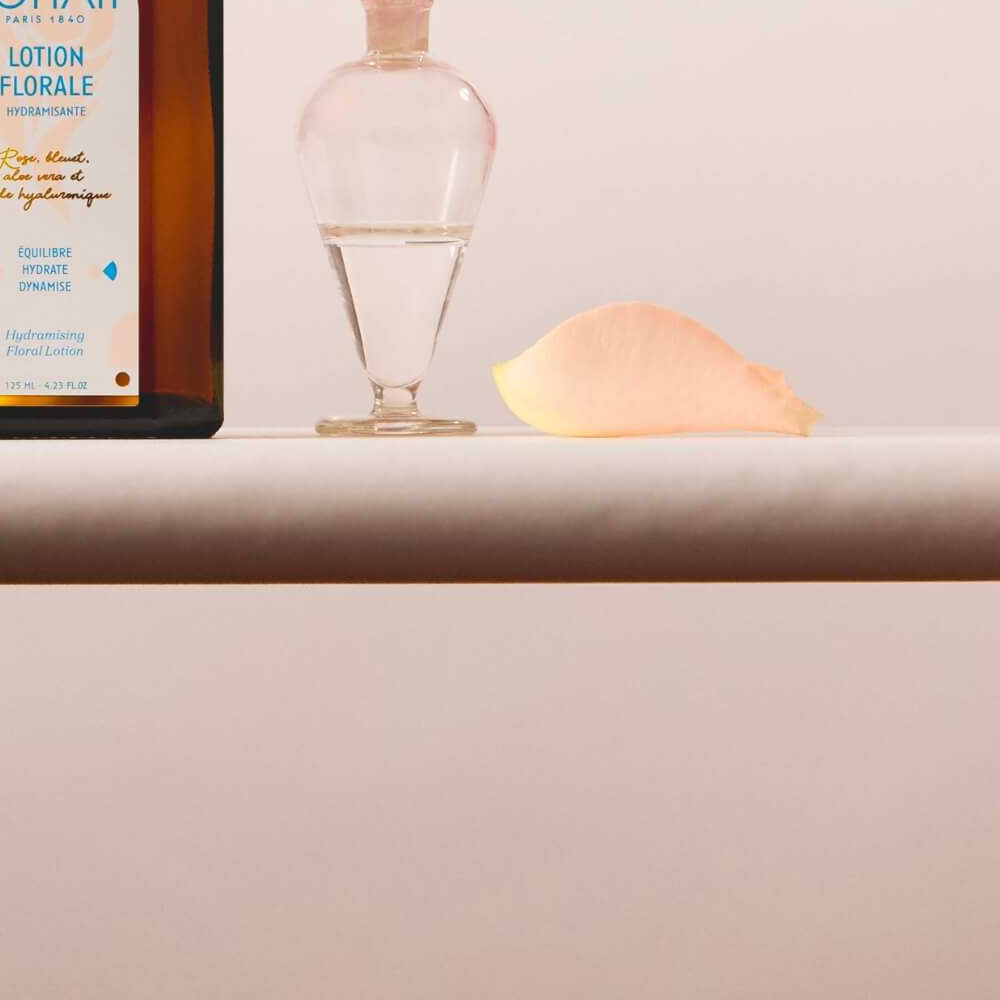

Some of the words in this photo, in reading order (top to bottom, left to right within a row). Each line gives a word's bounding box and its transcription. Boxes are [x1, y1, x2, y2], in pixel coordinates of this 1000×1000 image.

[5, 15, 42, 24] PARIS
[49, 15, 86, 24] 1840
[8, 46, 84, 67] LOTION
[0, 75, 94, 97] FLORALE
[6, 106, 87, 117] HYDRAMISANTE
[2, 169, 33, 182] aloe
[36, 173, 66, 182] vera
[70, 169, 85, 182] et
[17, 187, 113, 212] hyaluronique
[18, 246, 73, 259] ÉQUILIBRE
[22, 264, 69, 275] HYDRATE
[19, 281, 72, 292] DYNAMISE
[5, 329, 85, 343] Hydramising
[6, 346, 43, 357] Floral
[44, 346, 84, 357] Lotion
[5, 381, 21, 390] 125
[44, 381, 63, 390] 4.23
